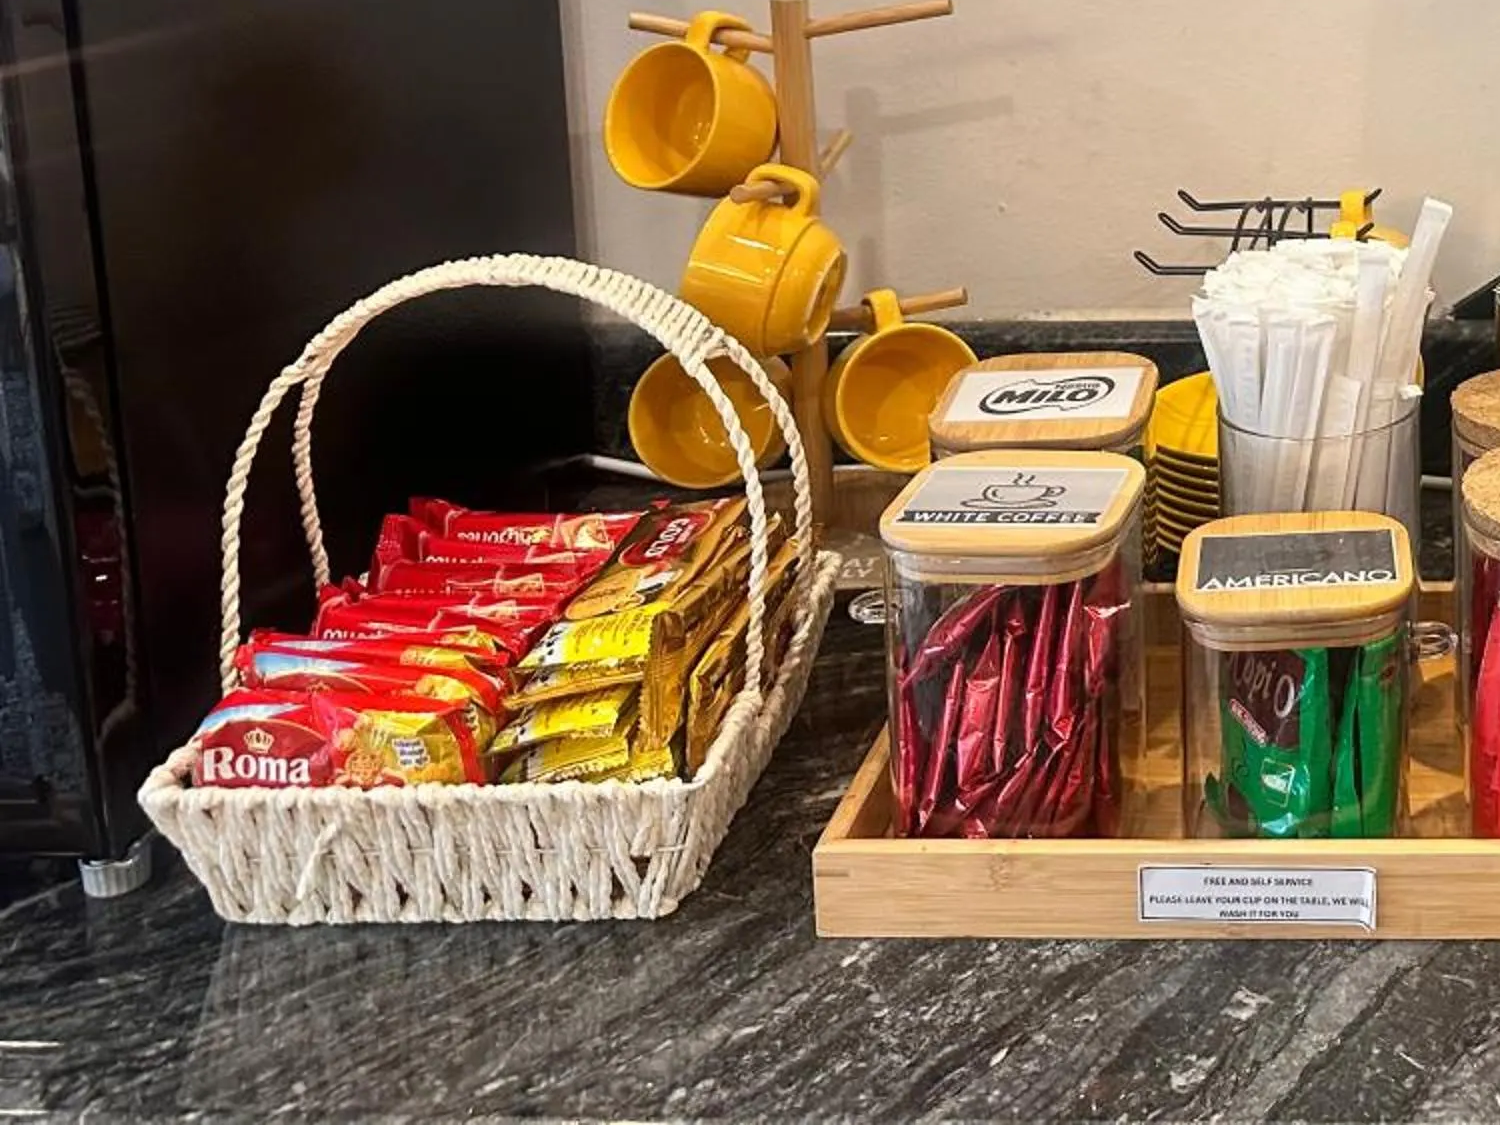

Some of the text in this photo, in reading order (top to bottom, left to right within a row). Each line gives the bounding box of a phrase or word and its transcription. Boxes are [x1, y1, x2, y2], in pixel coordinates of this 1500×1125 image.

[992, 388, 1099, 405] MILO
[914, 511, 1087, 523] WHITE COFFEE
[1200, 569, 1393, 591] AMERICANO
[202, 746, 311, 784] Roma
[1203, 877, 1313, 887] FREE AND SELF SERVICE
[1149, 895, 1182, 904] PLEASE
[1185, 895, 1212, 904] LEAVE
[1215, 896, 1240, 905] YOUR
[1242, 896, 1262, 905] CUP
[1263, 896, 1279, 905] ON
[1281, 896, 1298, 905] THE
[1332, 897, 1346, 906] WE
[1219, 910, 1300, 918] WASH IT FOR YOU
